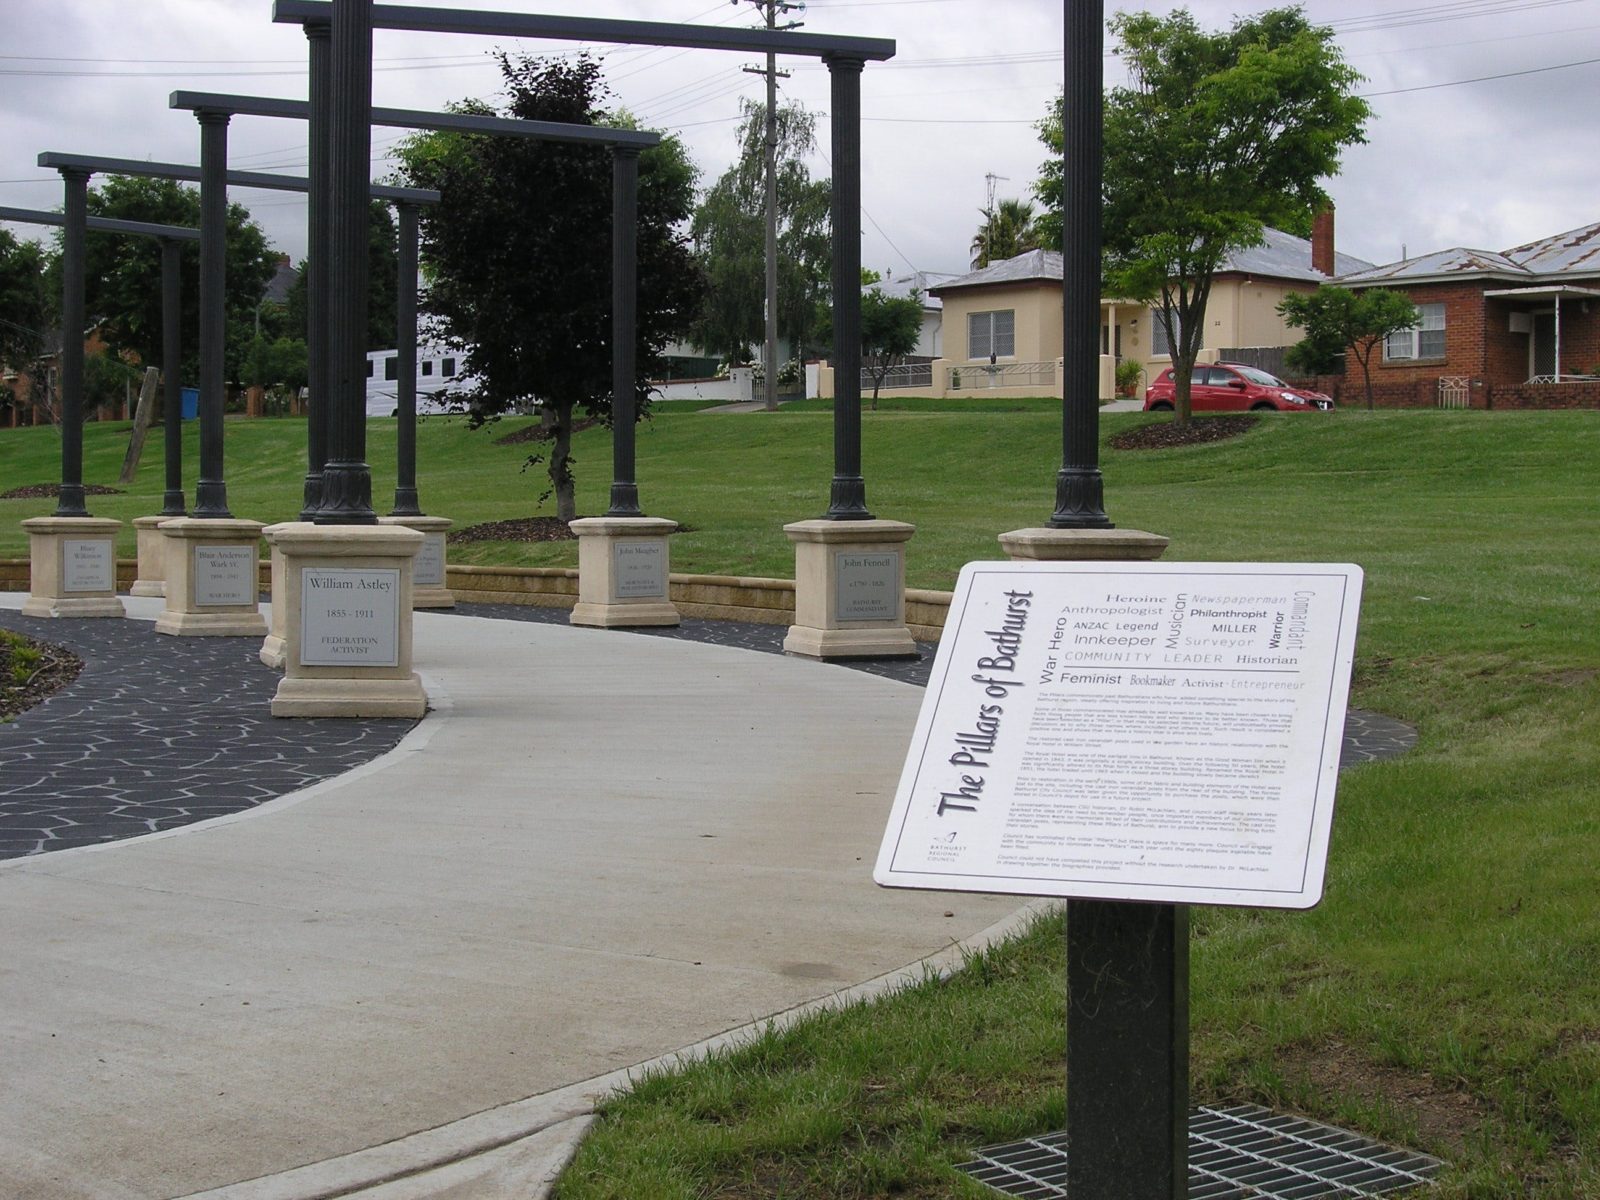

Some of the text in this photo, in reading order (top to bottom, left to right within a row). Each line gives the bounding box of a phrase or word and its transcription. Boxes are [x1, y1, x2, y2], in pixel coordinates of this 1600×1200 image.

[843, 559, 890, 569] John Fennell
[310, 577, 392, 592] William Astley
[1106, 594, 1287, 605] Heroine Newspaperman
[327, 609, 346, 618] 1855
[355, 610, 374, 618] 1911
[1061, 605, 1267, 619] Anthropologist Philanthropist
[1073, 622, 1159, 632] ANZAC Legend
[1164, 593, 1188, 649] Musician
[1212, 624, 1257, 633] MILLER
[1269, 611, 1285, 649] Warrior
[321, 636, 378, 644] FEDERATION
[1074, 634, 1254, 648] Innkeeper Surveyor
[331, 646, 369, 654] ACTIVIST
[1039, 617, 1067, 684] War Hero
[1064, 651, 1298, 665] COMMUNITY LEADER Historian
[1060, 673, 1306, 690] Feminist Bookmaker Activist Entrepreneur
[936, 589, 1034, 817] The Pillars of Bathurst
